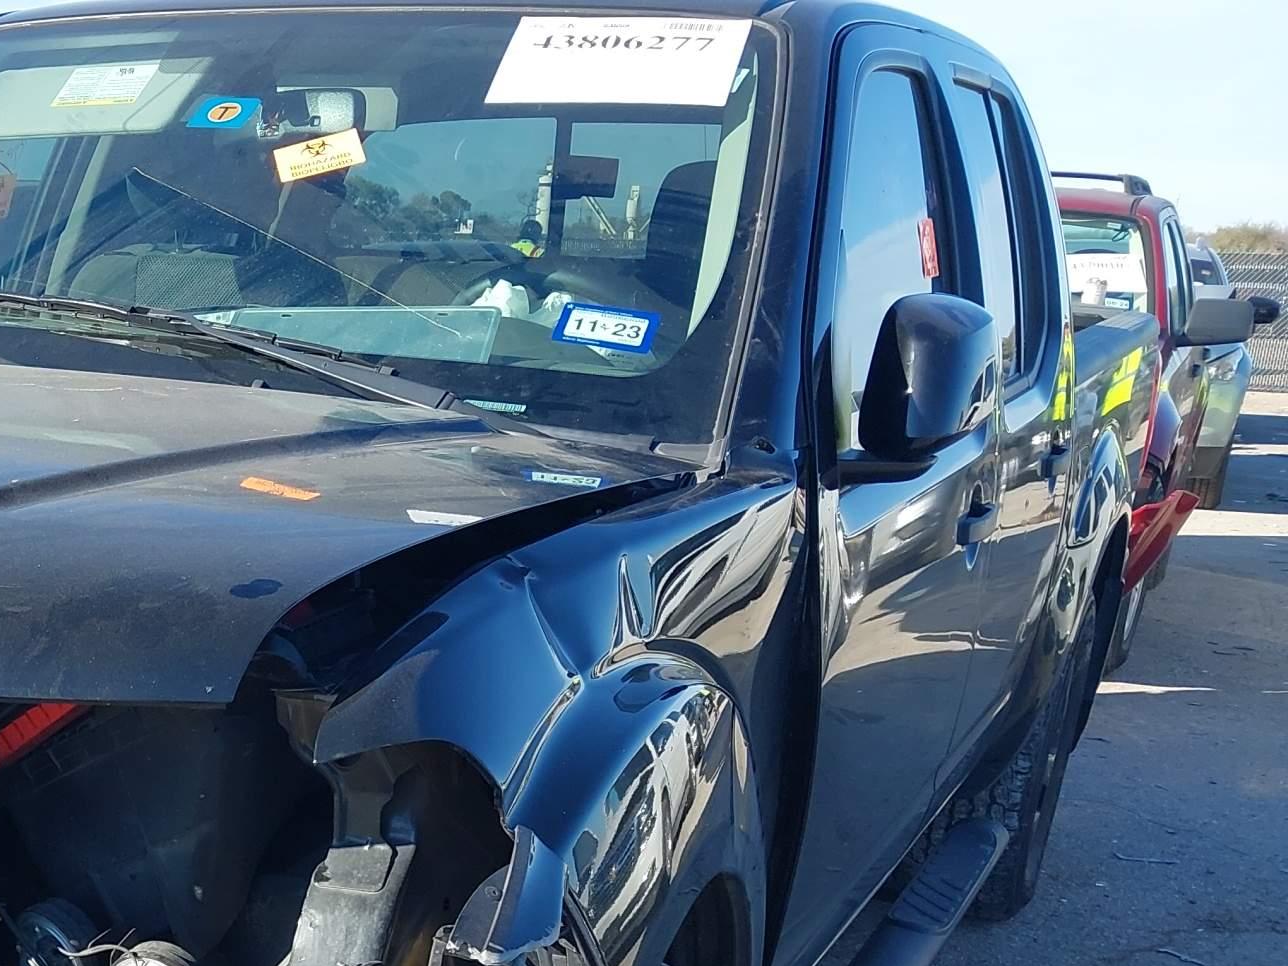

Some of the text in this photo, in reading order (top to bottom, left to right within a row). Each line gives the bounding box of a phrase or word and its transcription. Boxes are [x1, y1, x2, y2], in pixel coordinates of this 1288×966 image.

[533, 34, 715, 51] 43806277
[217, 106, 238, 120] T
[289, 151, 352, 172] BIOHAZARD
